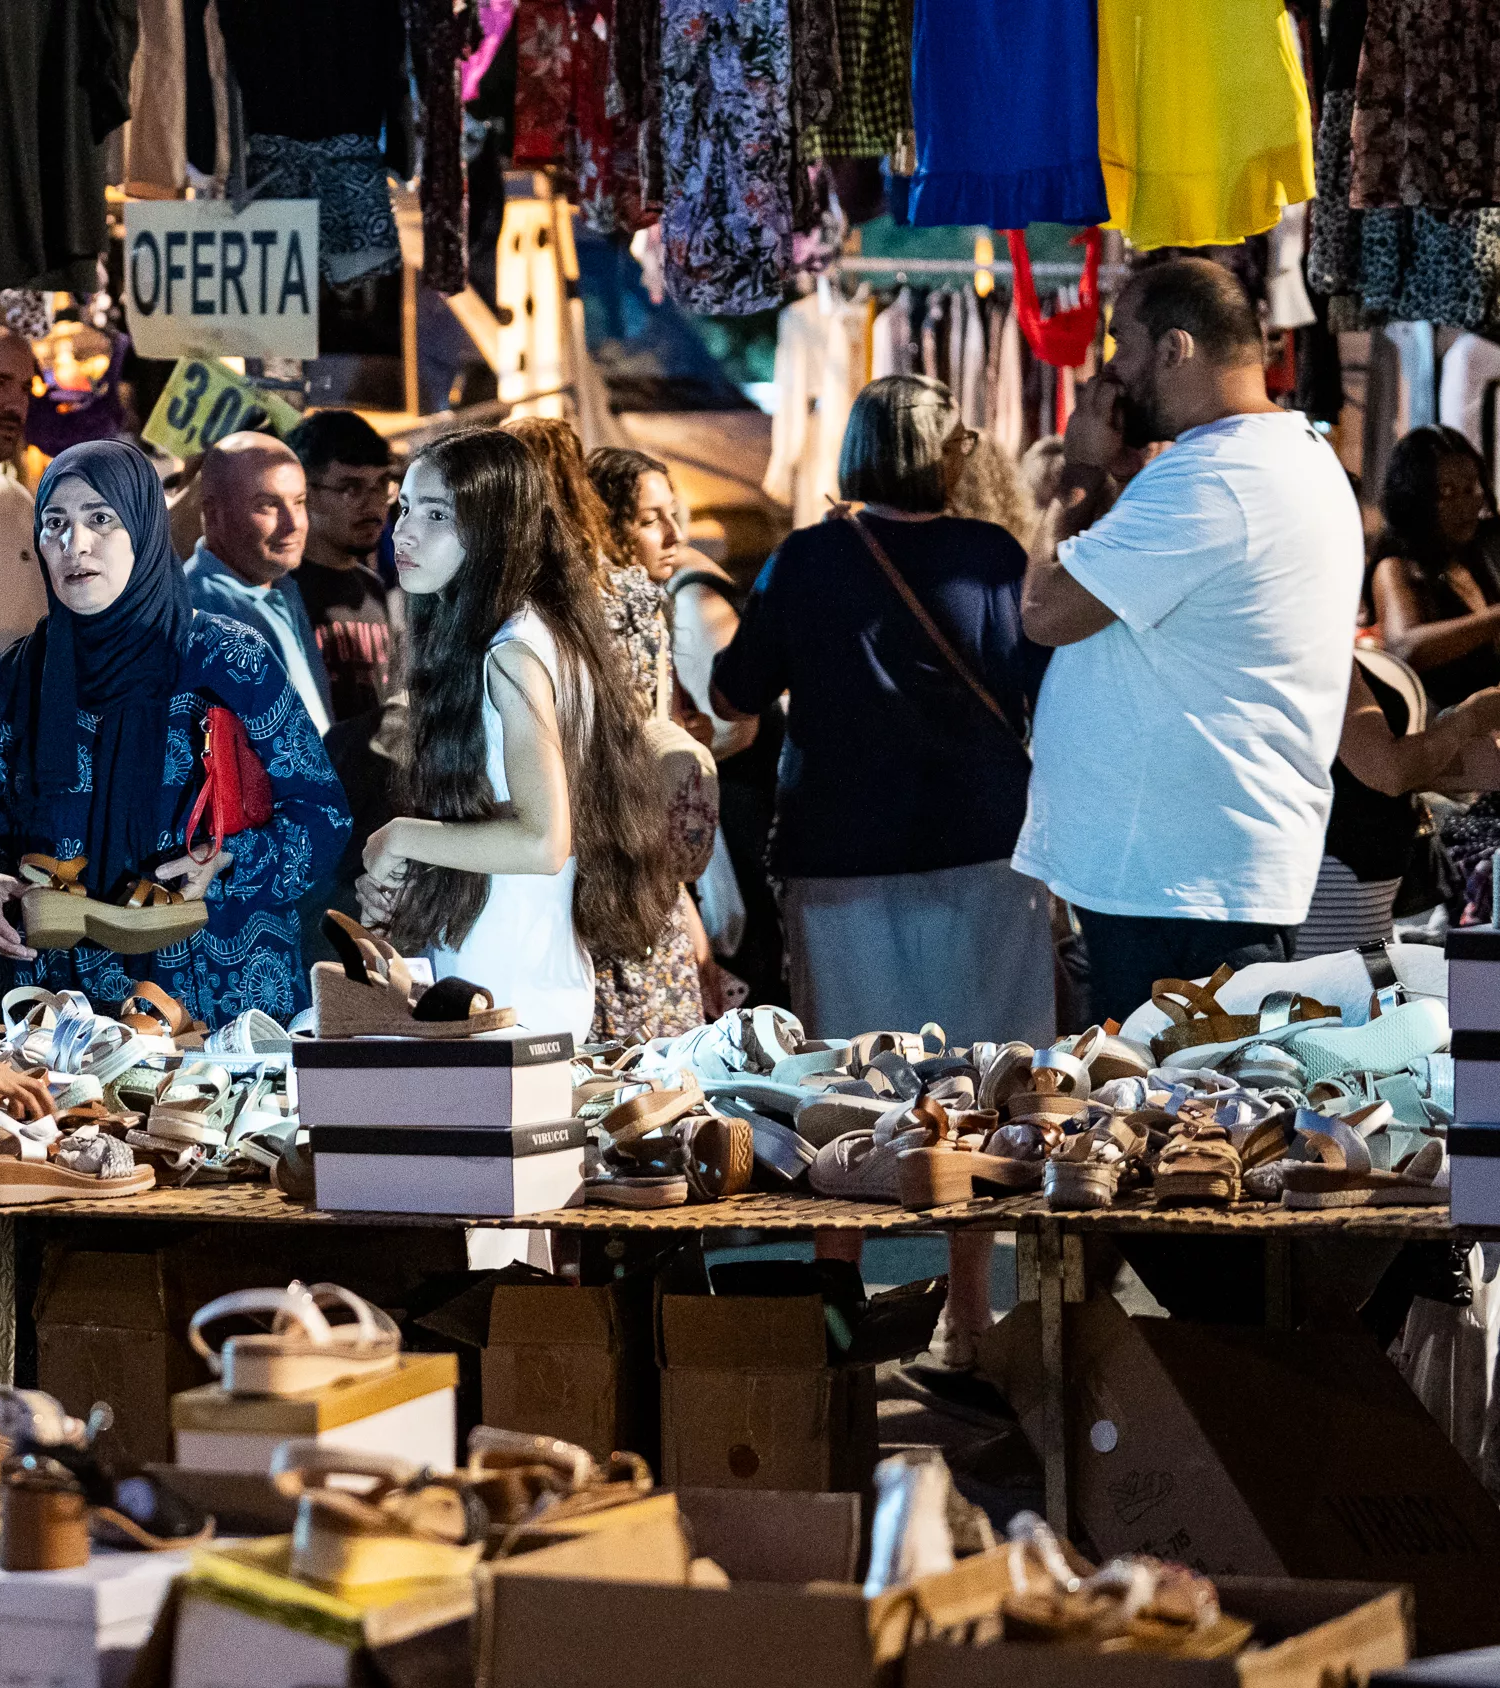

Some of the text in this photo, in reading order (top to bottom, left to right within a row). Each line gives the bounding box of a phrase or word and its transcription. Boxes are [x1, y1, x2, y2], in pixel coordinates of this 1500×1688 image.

[132, 230, 309, 315] OFERTA
[528, 1041, 561, 1056] VIRUCCI
[532, 1129, 569, 1145] VIRUCCI
